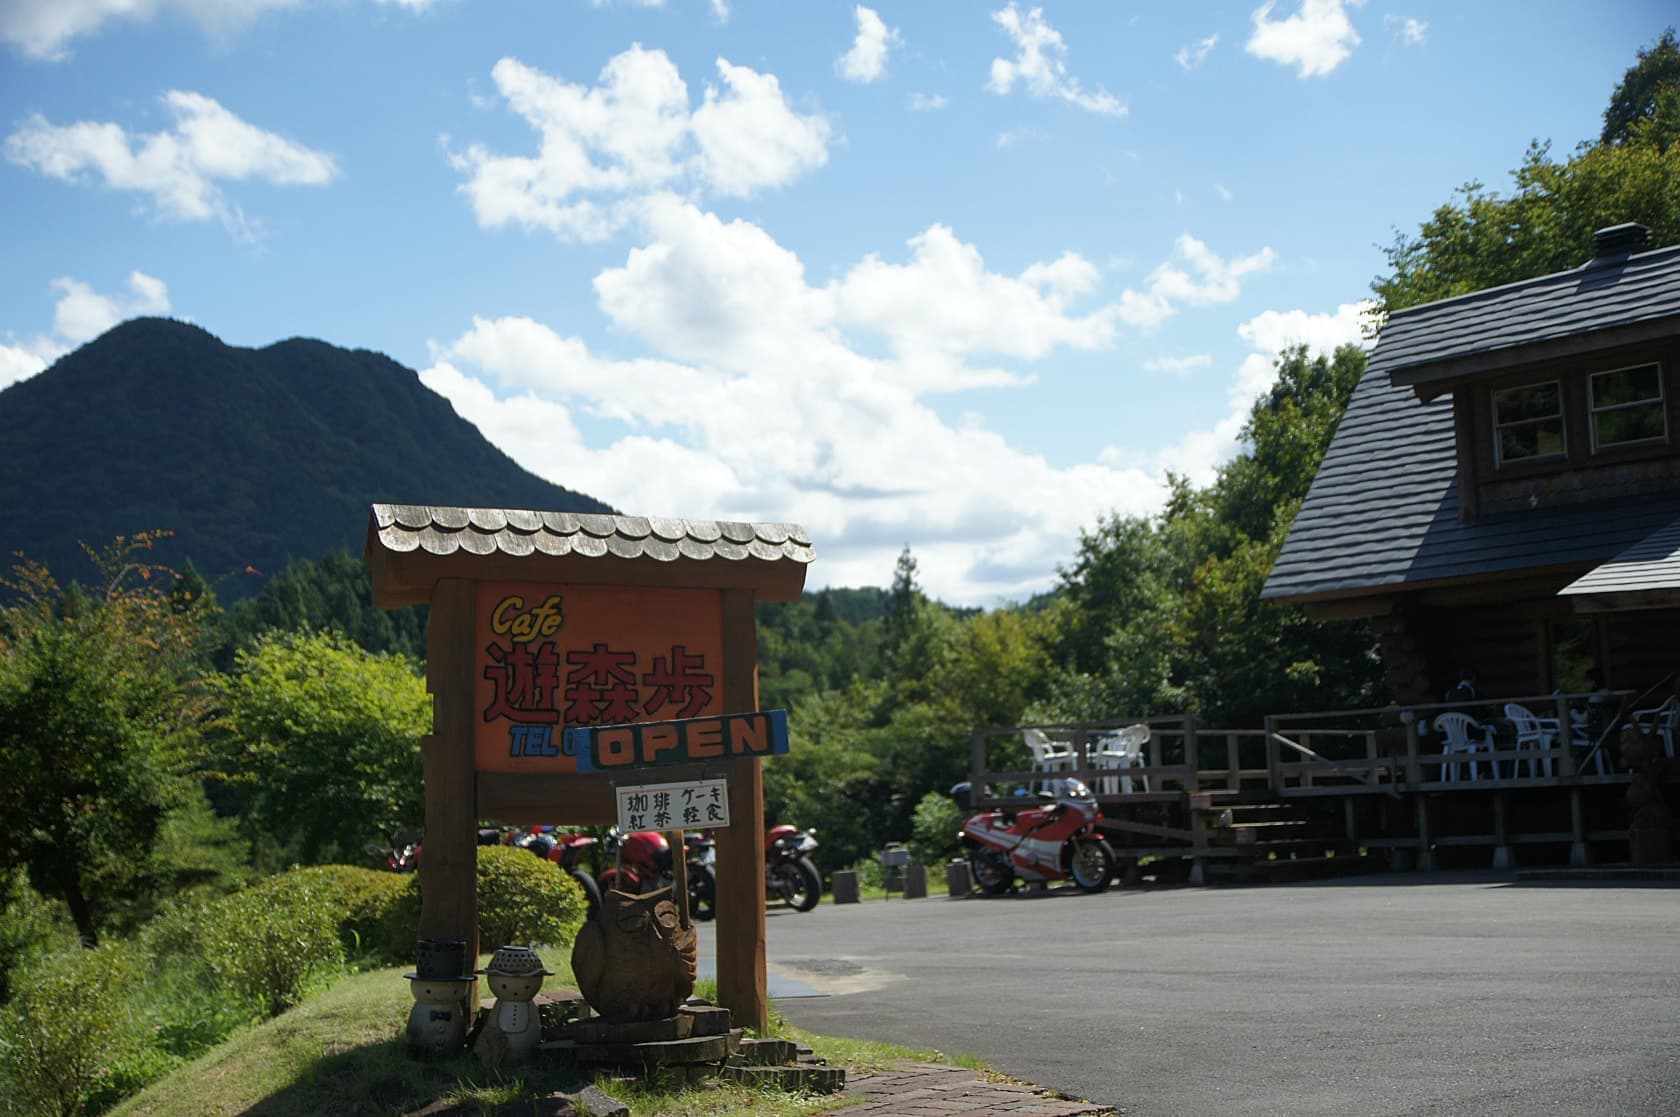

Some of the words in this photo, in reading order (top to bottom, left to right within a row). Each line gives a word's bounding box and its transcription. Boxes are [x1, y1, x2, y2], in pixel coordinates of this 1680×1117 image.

[484, 641, 713, 723] 遊森歩
[510, 726, 559, 757] TEL
[598, 716, 769, 766] OPEN
[627, 792, 671, 813] 珈琲
[681, 787, 721, 805] ケーキ
[628, 811, 672, 830] 紅茶
[682, 803, 725, 824] 軽食
